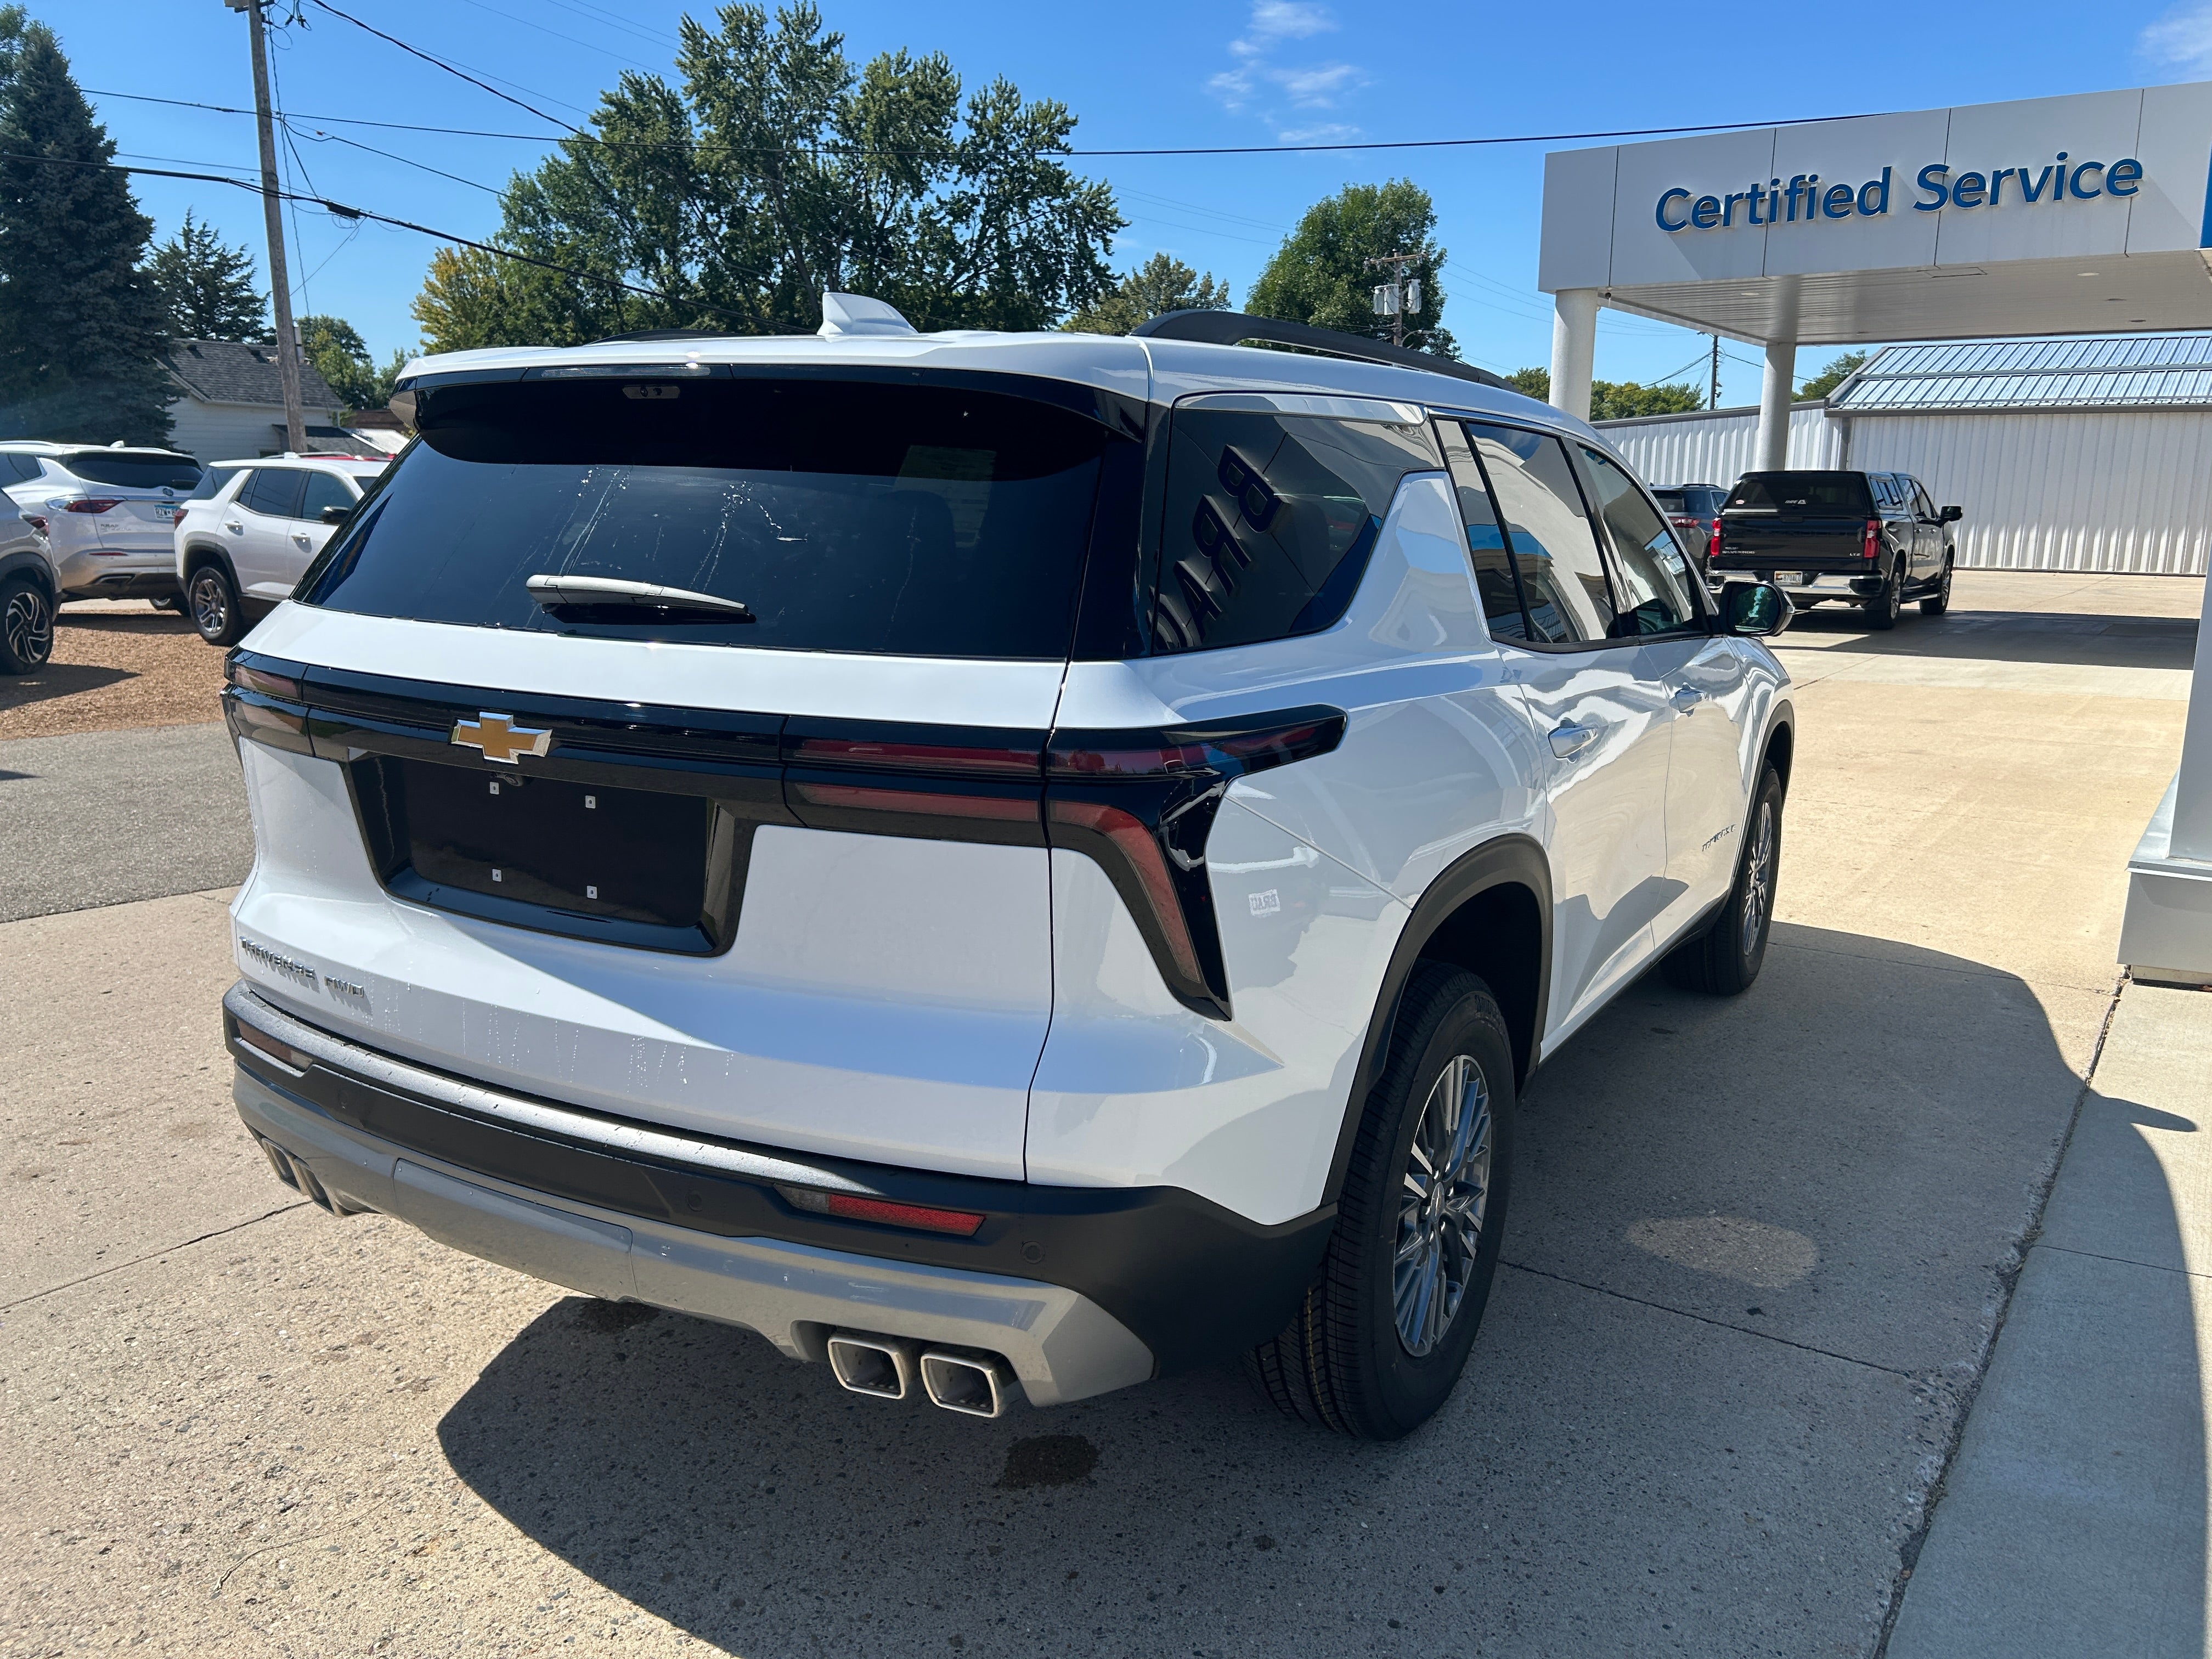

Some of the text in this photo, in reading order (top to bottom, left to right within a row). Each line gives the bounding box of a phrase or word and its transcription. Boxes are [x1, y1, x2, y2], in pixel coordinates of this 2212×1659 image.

[1655, 151, 2144, 233] Certified Service
[324, 975, 364, 997] FWD
